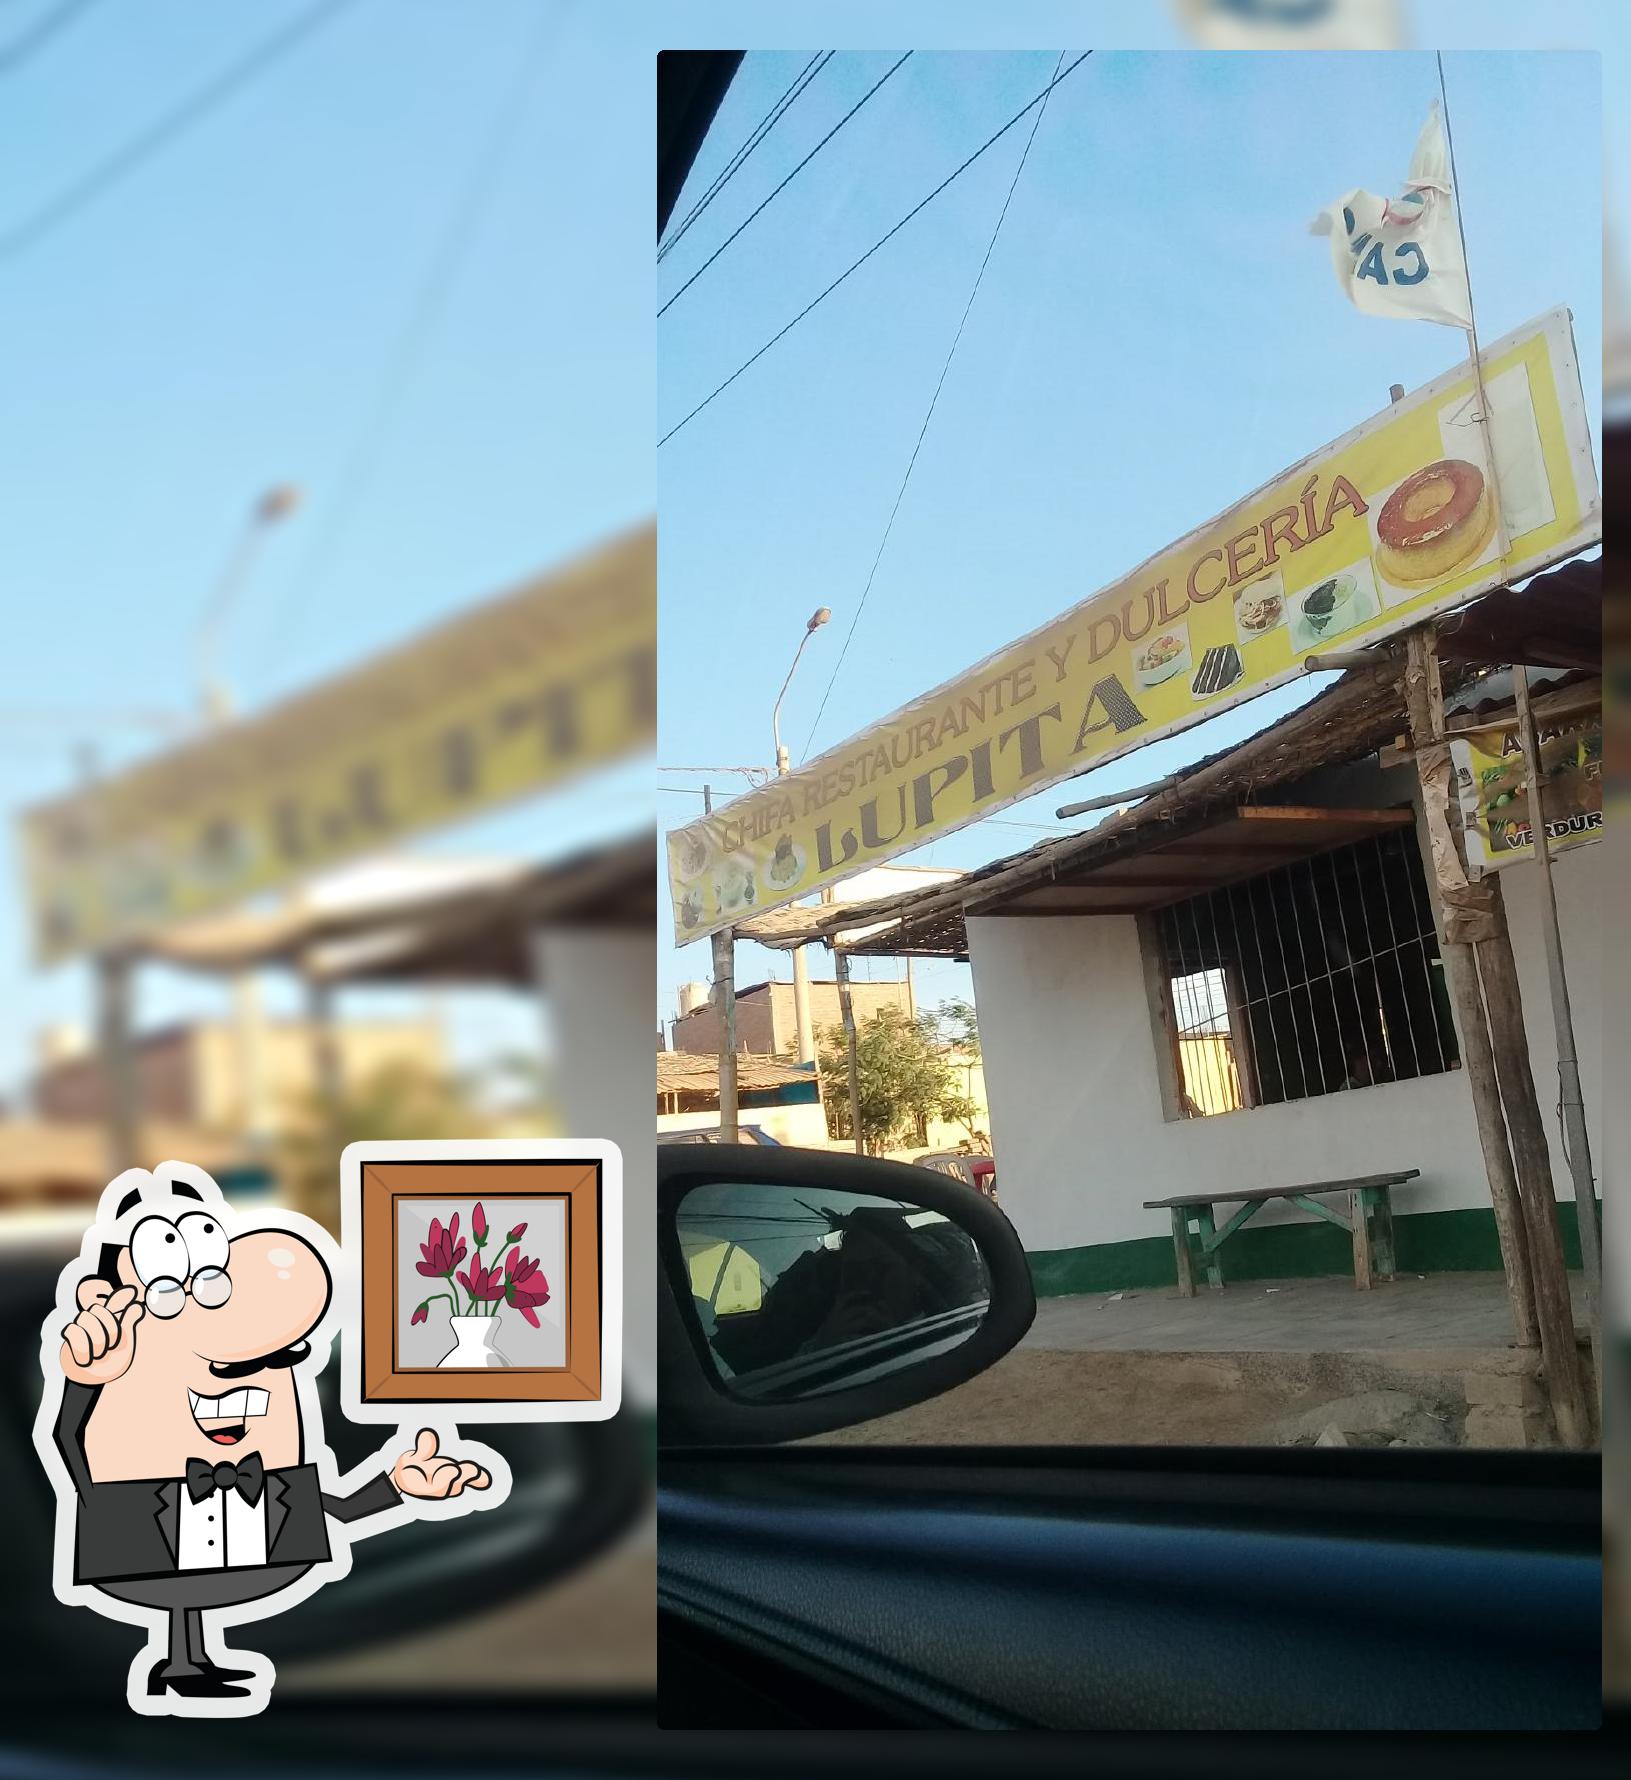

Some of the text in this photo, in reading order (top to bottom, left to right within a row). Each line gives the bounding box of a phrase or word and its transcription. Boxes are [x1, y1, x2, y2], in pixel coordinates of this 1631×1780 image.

[723, 474, 1369, 853] CHIFA RESTAURANTE Y DULCERÍA
[816, 673, 1148, 873] LUPITA
